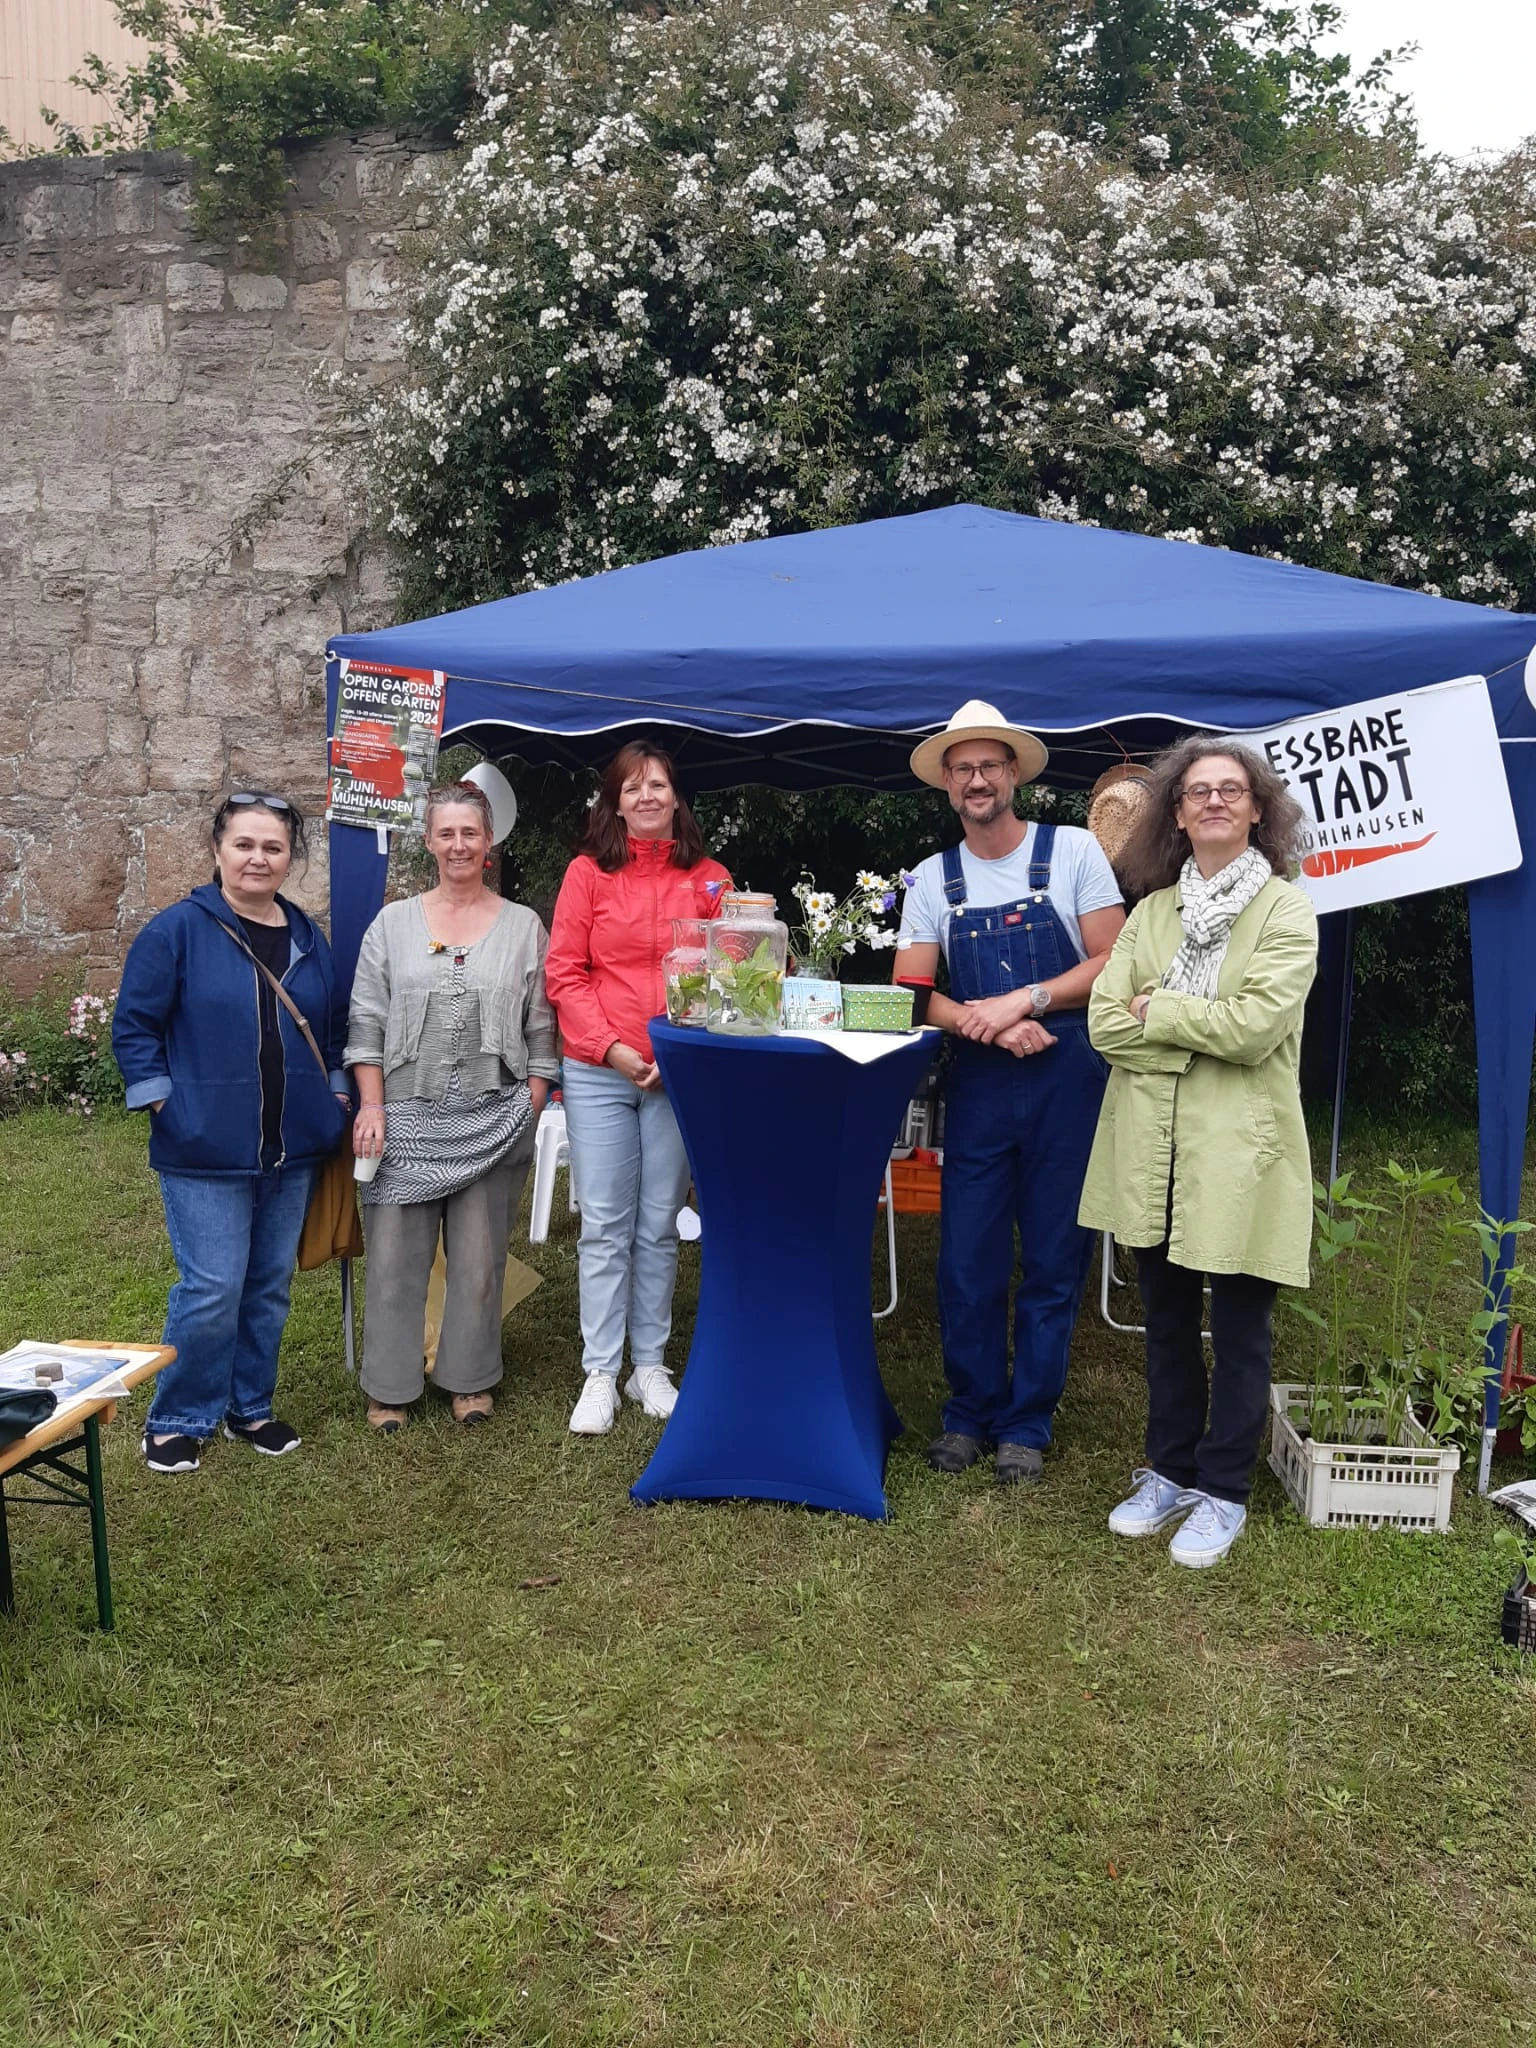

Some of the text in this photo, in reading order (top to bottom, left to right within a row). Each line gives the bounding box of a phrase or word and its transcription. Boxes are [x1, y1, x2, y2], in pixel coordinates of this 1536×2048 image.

[349, 663, 392, 673] ARTENWELTEN
[344, 673, 441, 697] OPEN GARDENS
[342, 687, 389, 705] OFFENE
[390, 692, 440, 712] GÄRTEN
[409, 710, 439, 726] 2024
[1263, 708, 1408, 776] ESSBARE
[333, 777, 344, 790] 2.
[347, 779, 375, 794] JUNI
[1283, 747, 1413, 824] TADT
[331, 789, 413, 814] MÜHLHAUSEN
